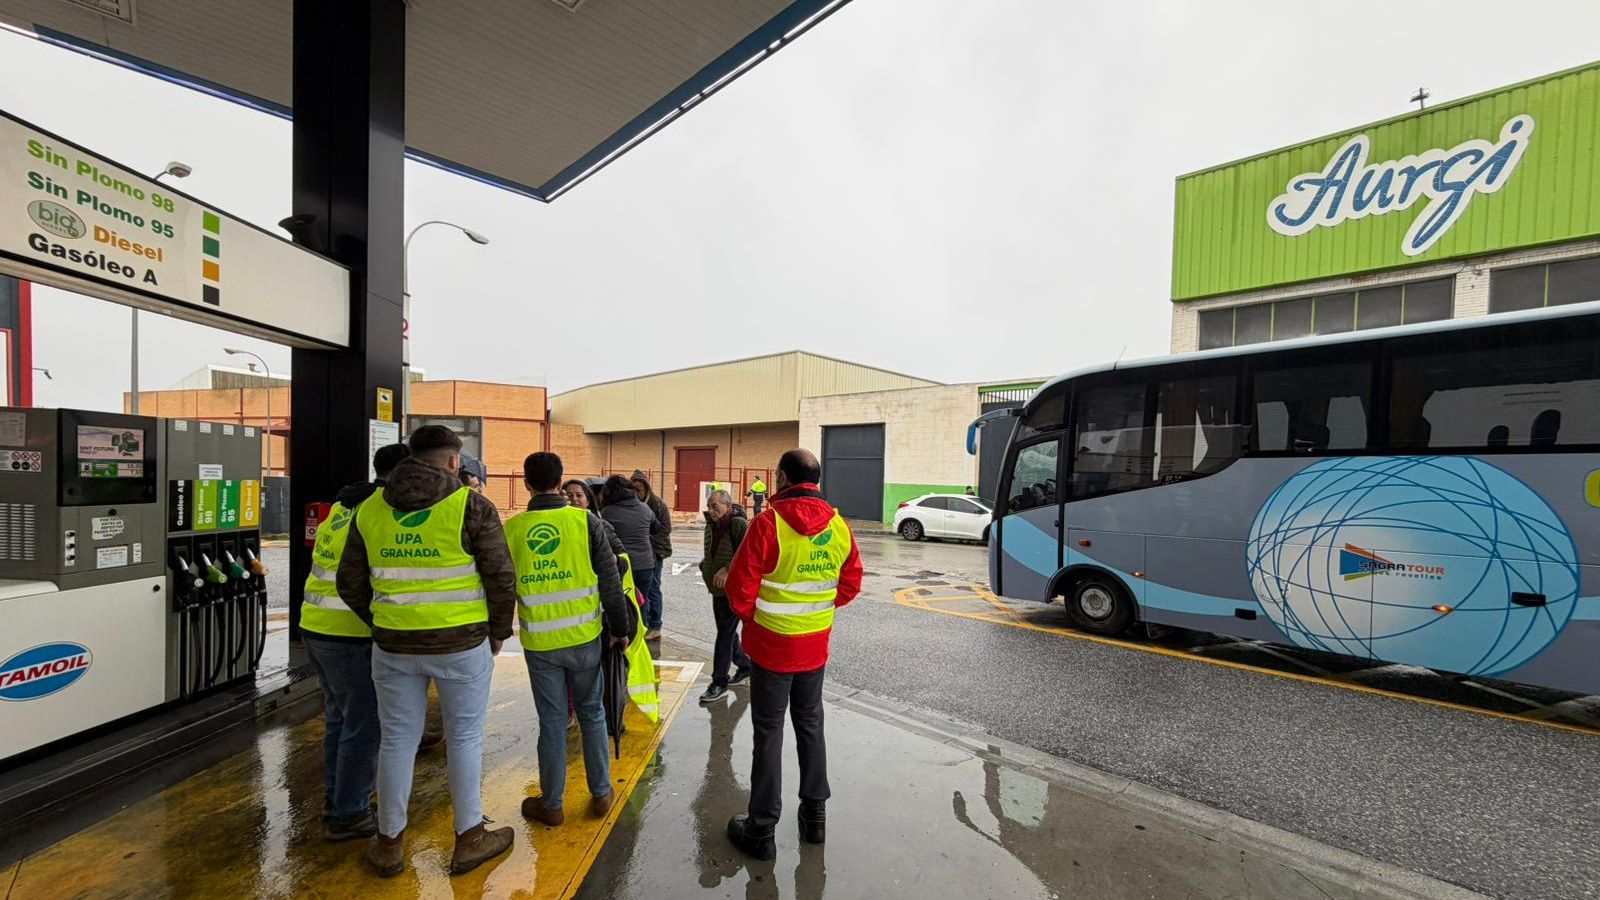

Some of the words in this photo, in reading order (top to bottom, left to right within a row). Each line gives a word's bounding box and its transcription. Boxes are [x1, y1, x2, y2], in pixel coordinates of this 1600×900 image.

[27, 139, 68, 170] Sin
[76, 160, 145, 201] Plomo
[151, 192, 174, 213] 98
[1269, 116, 1532, 255] Aurgi
[27, 171, 68, 200] Sin
[76, 189, 145, 228] Plomo
[151, 219, 174, 239] 95
[93, 225, 163, 262] Diesel
[28, 233, 135, 279] Gasóleo
[142, 268, 158, 286] A
[205, 511, 213, 524] 98
[227, 509, 236, 522] 95
[395, 533, 423, 545] UPA
[380, 548, 441, 558] GRANADA
[810, 550, 829, 560] UPA
[533, 559, 558, 571] UPA
[797, 562, 837, 573] GRANADA
[520, 570, 573, 584] GRANADA
[0, 655, 89, 687] TAMOIL
